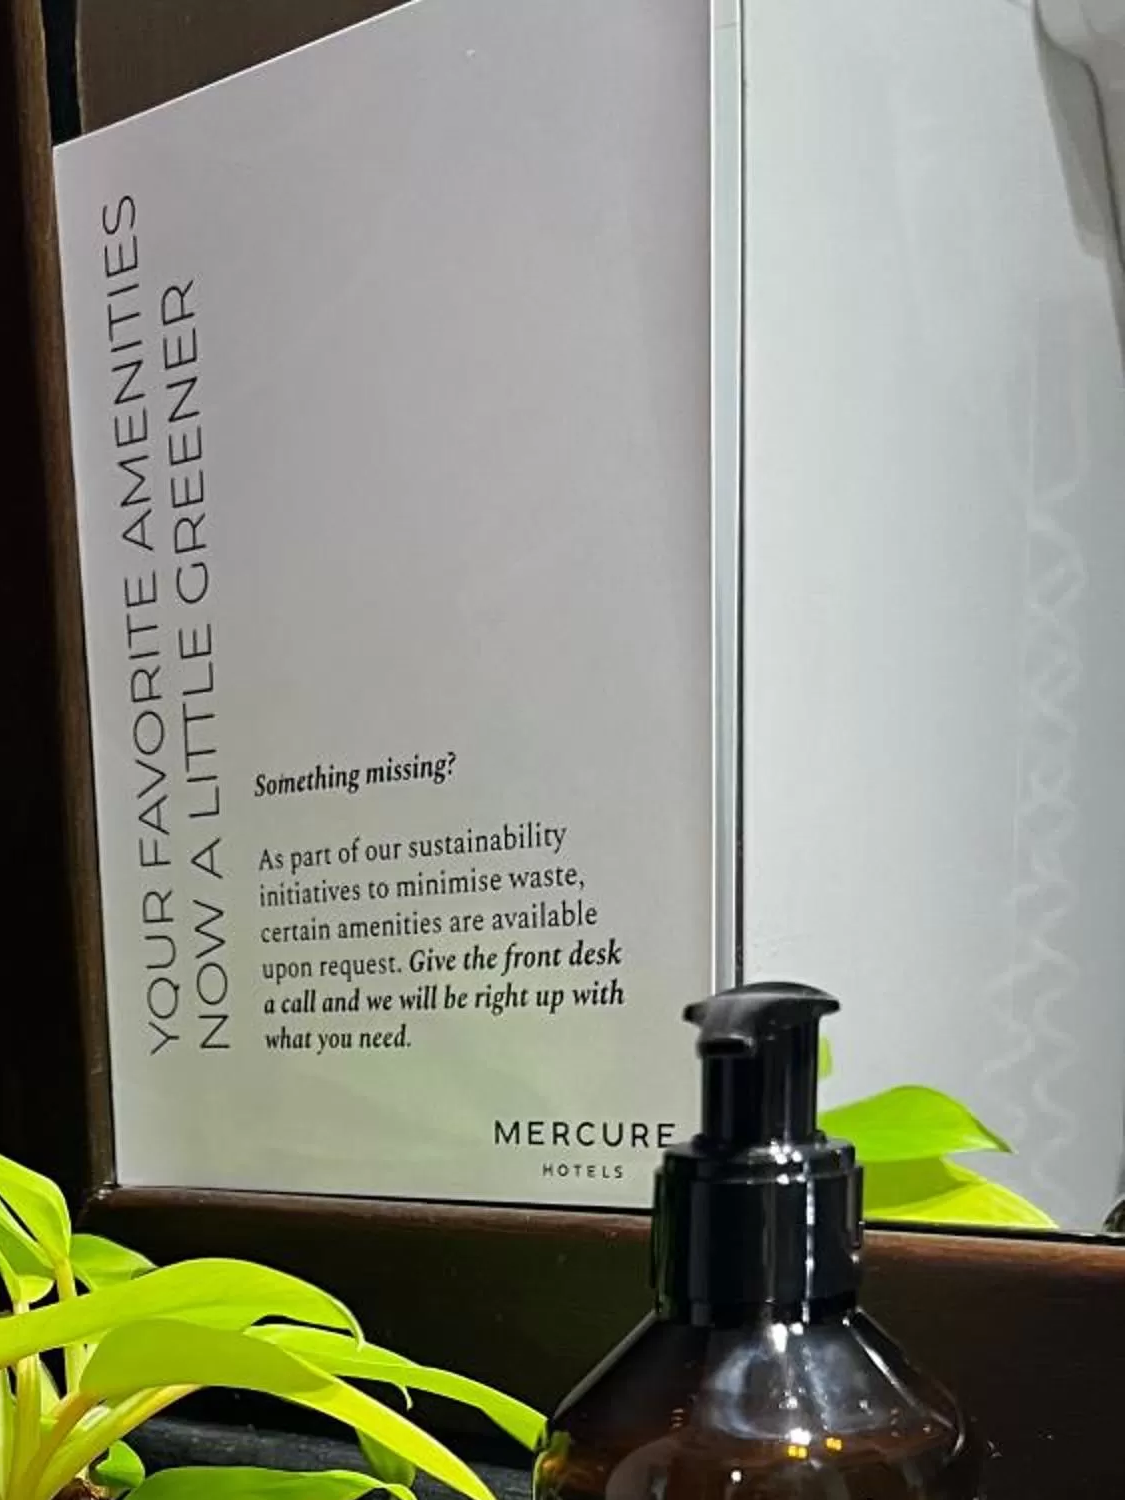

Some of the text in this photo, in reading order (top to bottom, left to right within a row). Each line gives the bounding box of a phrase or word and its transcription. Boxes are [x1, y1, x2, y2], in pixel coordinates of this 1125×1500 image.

[102, 195, 154, 551] AMENITIES
[161, 279, 230, 1049] NOW A LITTLE GREENER
[124, 570, 172, 868] FAVORITE
[254, 751, 457, 797] Something missing?
[258, 820, 567, 875] As part of our sustainability
[259, 866, 585, 908] initiatives to minimise waste,
[261, 899, 598, 943] certain amenities are available
[262, 937, 623, 985] upon request. Give the front desk
[264, 978, 626, 1016] a call and we will be right up with
[266, 1023, 412, 1056] what you need.
[494, 1120, 676, 1149] MERCURE
[542, 1163, 624, 1179] HOTELS
